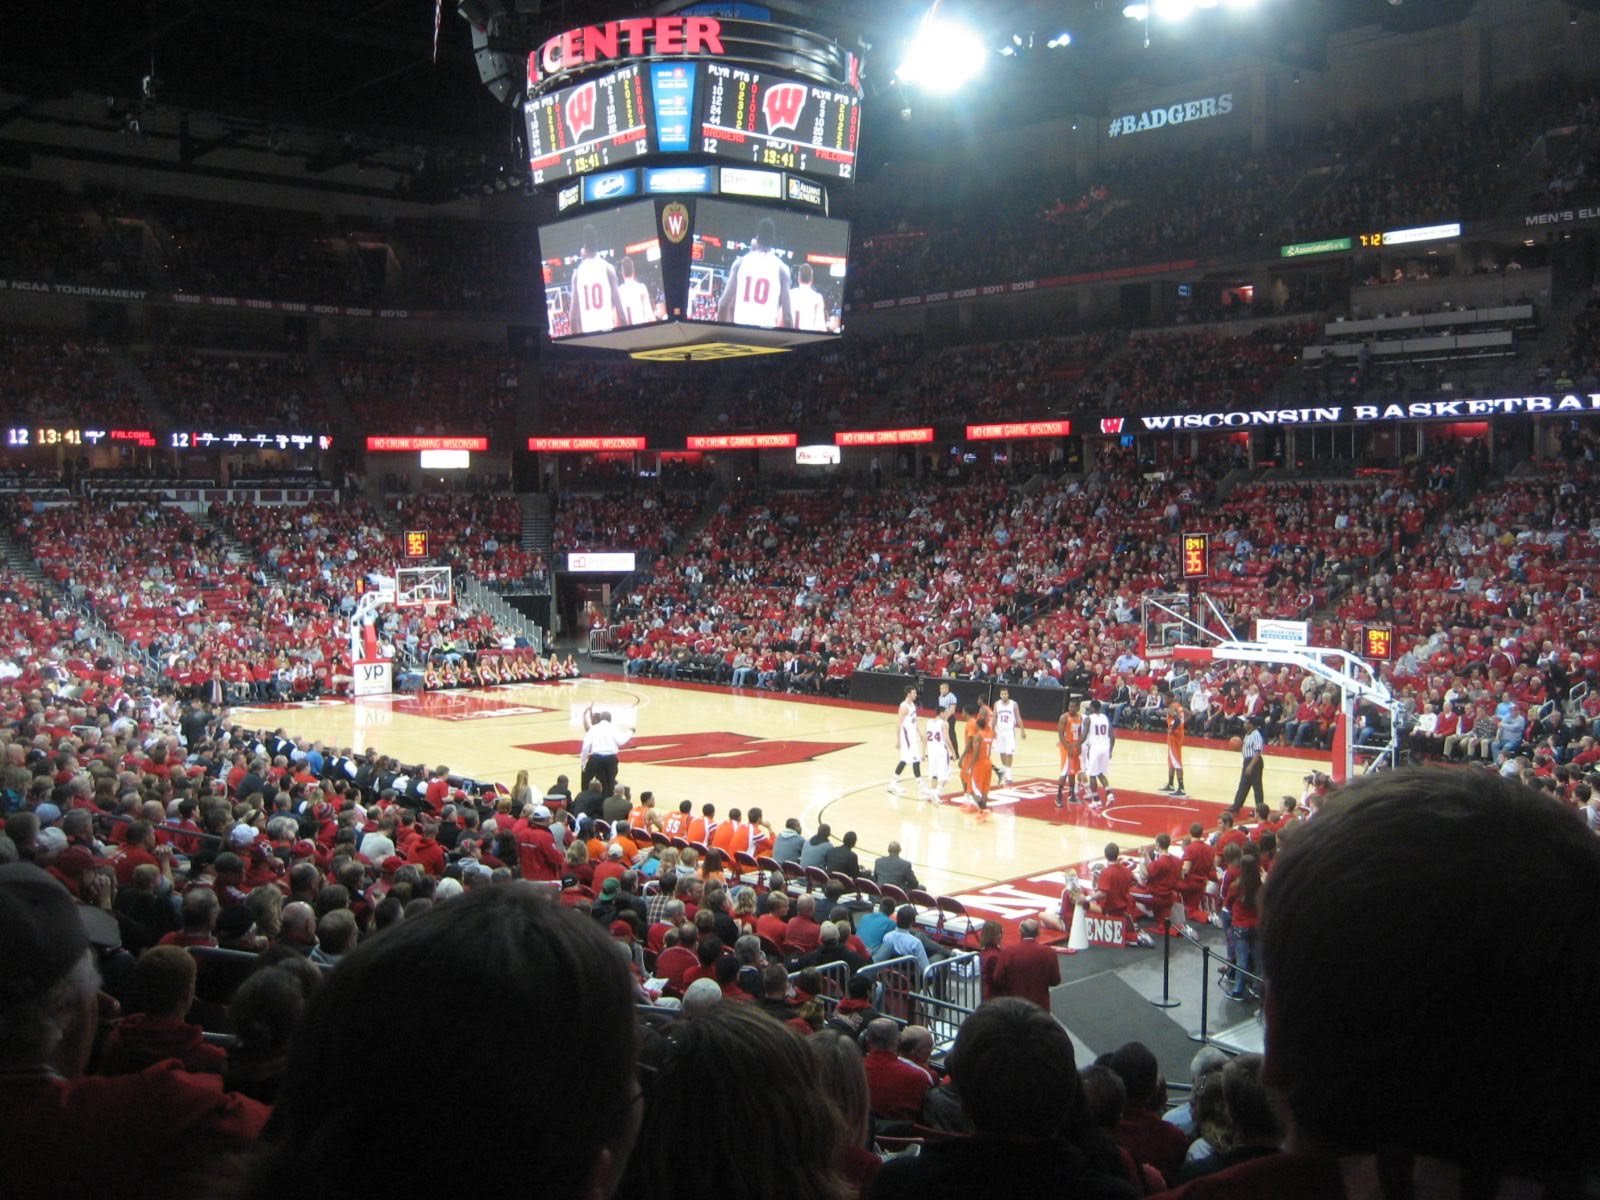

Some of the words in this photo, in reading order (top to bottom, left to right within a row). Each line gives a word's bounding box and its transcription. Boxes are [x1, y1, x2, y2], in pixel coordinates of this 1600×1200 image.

[543, 16, 724, 73] CENTER
[599, 74, 615, 88] PLYR
[618, 70, 631, 80] PTS
[709, 64, 730, 78] PLYR
[734, 70, 750, 82] PTS
[713, 86, 723, 96] 10
[812, 88, 830, 101] PLYR
[834, 94, 849, 104] PTS
[712, 95, 722, 106] 12
[1109, 93, 1232, 137] #BADGERS
[704, 127, 744, 143] BADGERS
[636, 140, 647, 155] 12
[704, 138, 718, 153] 12
[575, 153, 600, 172] 13:41
[764, 150, 794, 168] 13:41
[534, 169, 544, 184] 12
[839, 163, 852, 178] 12
[668, 215, 683, 236] W
[1525, 211, 1574, 226] MEN'S
[1360, 234, 1380, 247] 7:12
[12, 283, 50, 292] NCAA
[55, 284, 146, 299] TOURNAMENT
[744, 276, 770, 305] 10
[984, 285, 1003, 294] 2011
[1012, 280, 1034, 291] 2012
[584, 282, 603, 311] 10
[380, 310, 408, 318] 2010
[1141, 407, 1342, 430] WISCONSIN
[9, 428, 29, 444] 12
[38, 428, 82, 444] 13:41
[111, 430, 150, 438] FALCONS
[1004, 424, 1028, 436] GAMING
[1030, 422, 1062, 435] WISCONSIN
[172, 433, 188, 446] 12
[412, 440, 440, 449] GAMING
[443, 440, 480, 449] WISCONSIN
[573, 440, 600, 448] GAMING
[602, 440, 638, 448] WISCONSIN
[730, 437, 755, 448] GAMING
[756, 436, 790, 447] WISCONSIN
[408, 541, 423, 554] 35
[1186, 552, 1202, 572] 35
[1370, 640, 1385, 655] 35
[364, 664, 384, 680] yp
[1000, 715, 1009, 723] 12
[926, 730, 941, 742] 24
[1095, 724, 1107, 736] 10
[666, 818, 680, 834] 35
